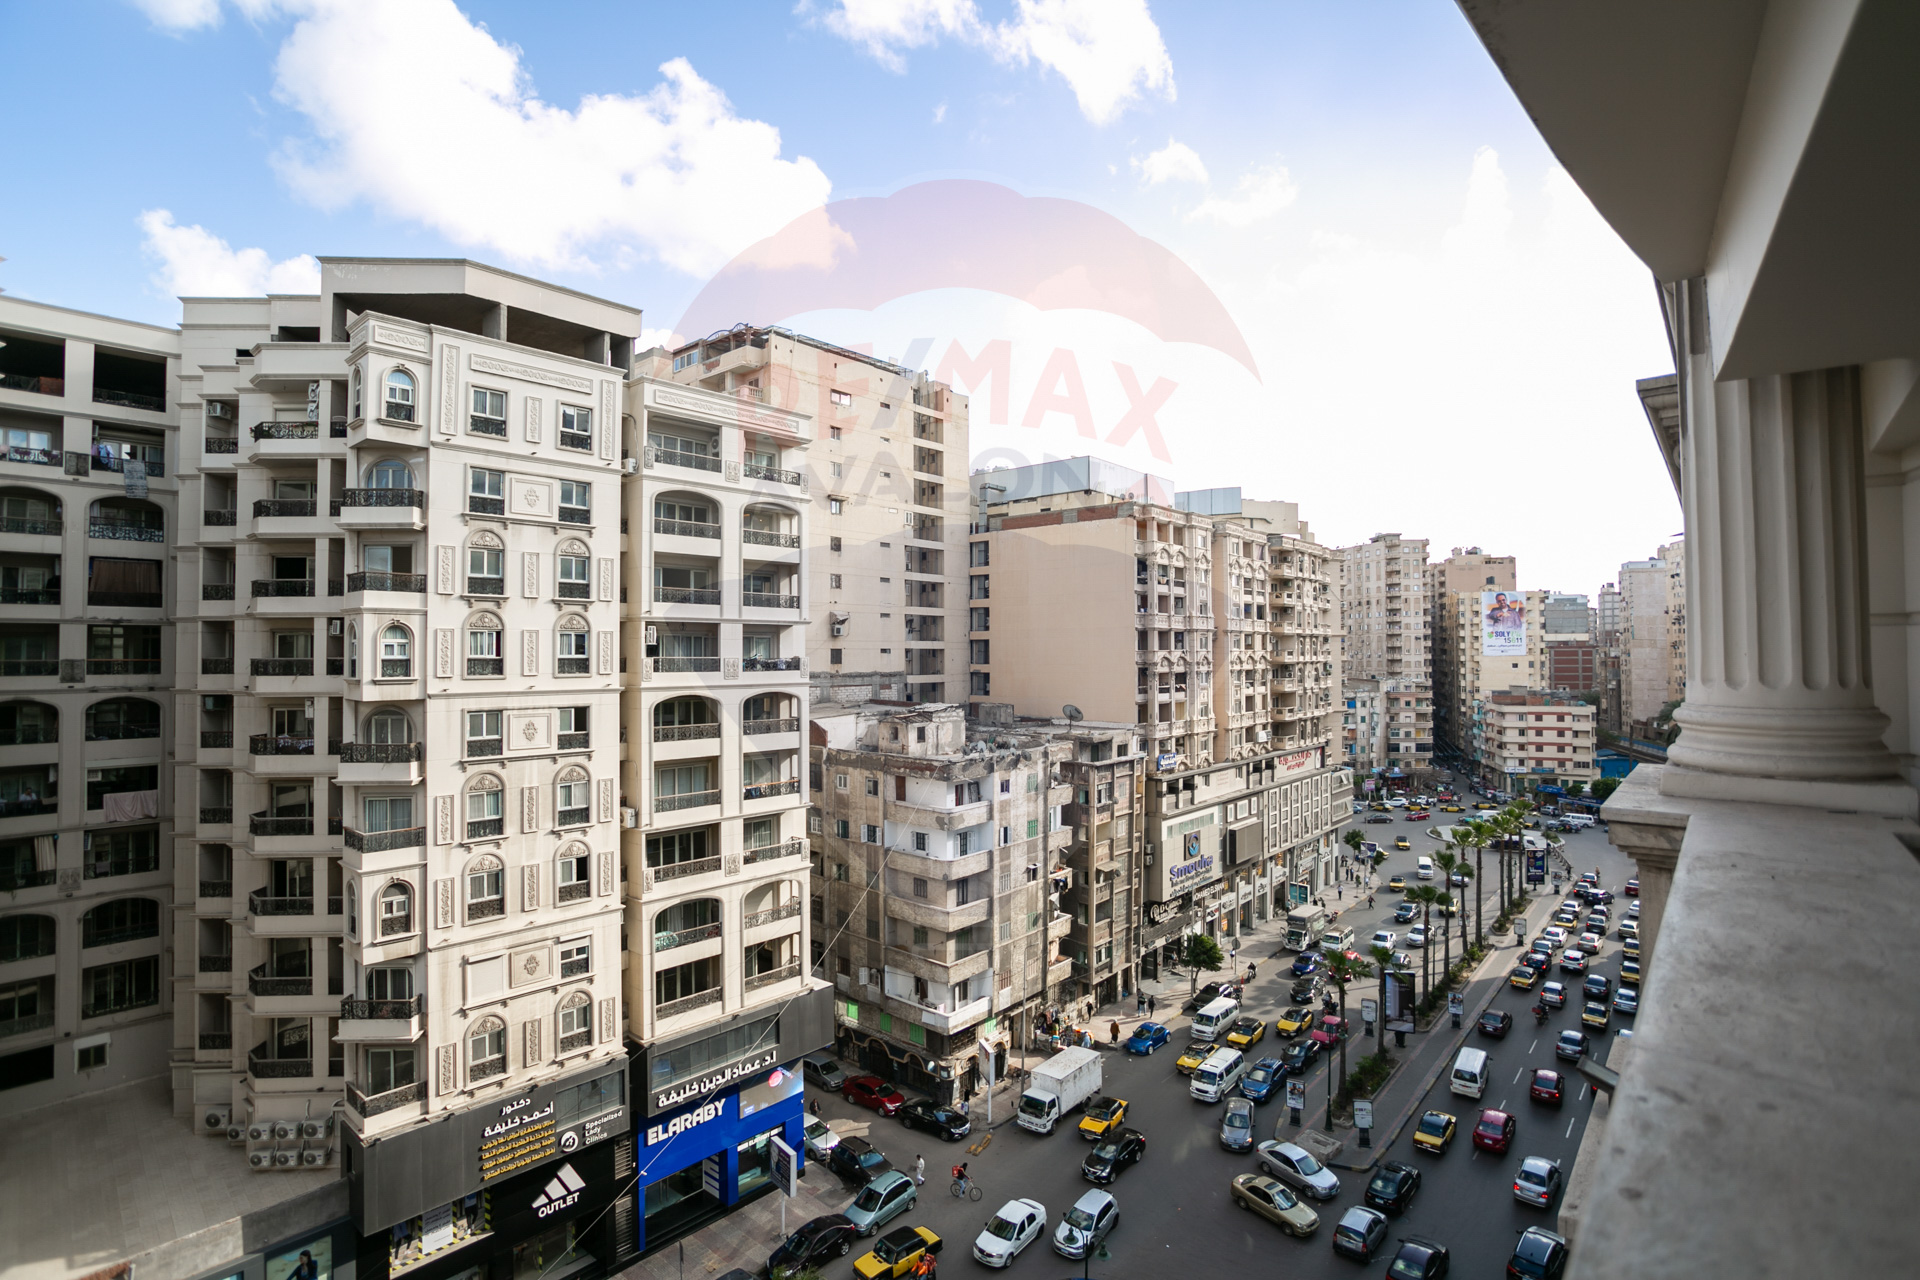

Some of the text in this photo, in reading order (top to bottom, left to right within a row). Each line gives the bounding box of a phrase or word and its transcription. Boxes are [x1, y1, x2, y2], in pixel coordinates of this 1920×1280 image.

[1170, 854, 1214, 882] Smouha
[732, 1059, 761, 1078] عماد
[701, 1068, 732, 1093] الدين
[658, 1082, 699, 1108] خليفة
[501, 1098, 530, 1116] دكتور
[484, 1115, 520, 1137] خليفة
[585, 1110, 623, 1129] Specialized
[647, 1098, 726, 1146] ELARABY
[585, 1126, 601, 1137] Lady
[585, 1132, 608, 1144] Clinics
[538, 1192, 580, 1218] OUTLET
